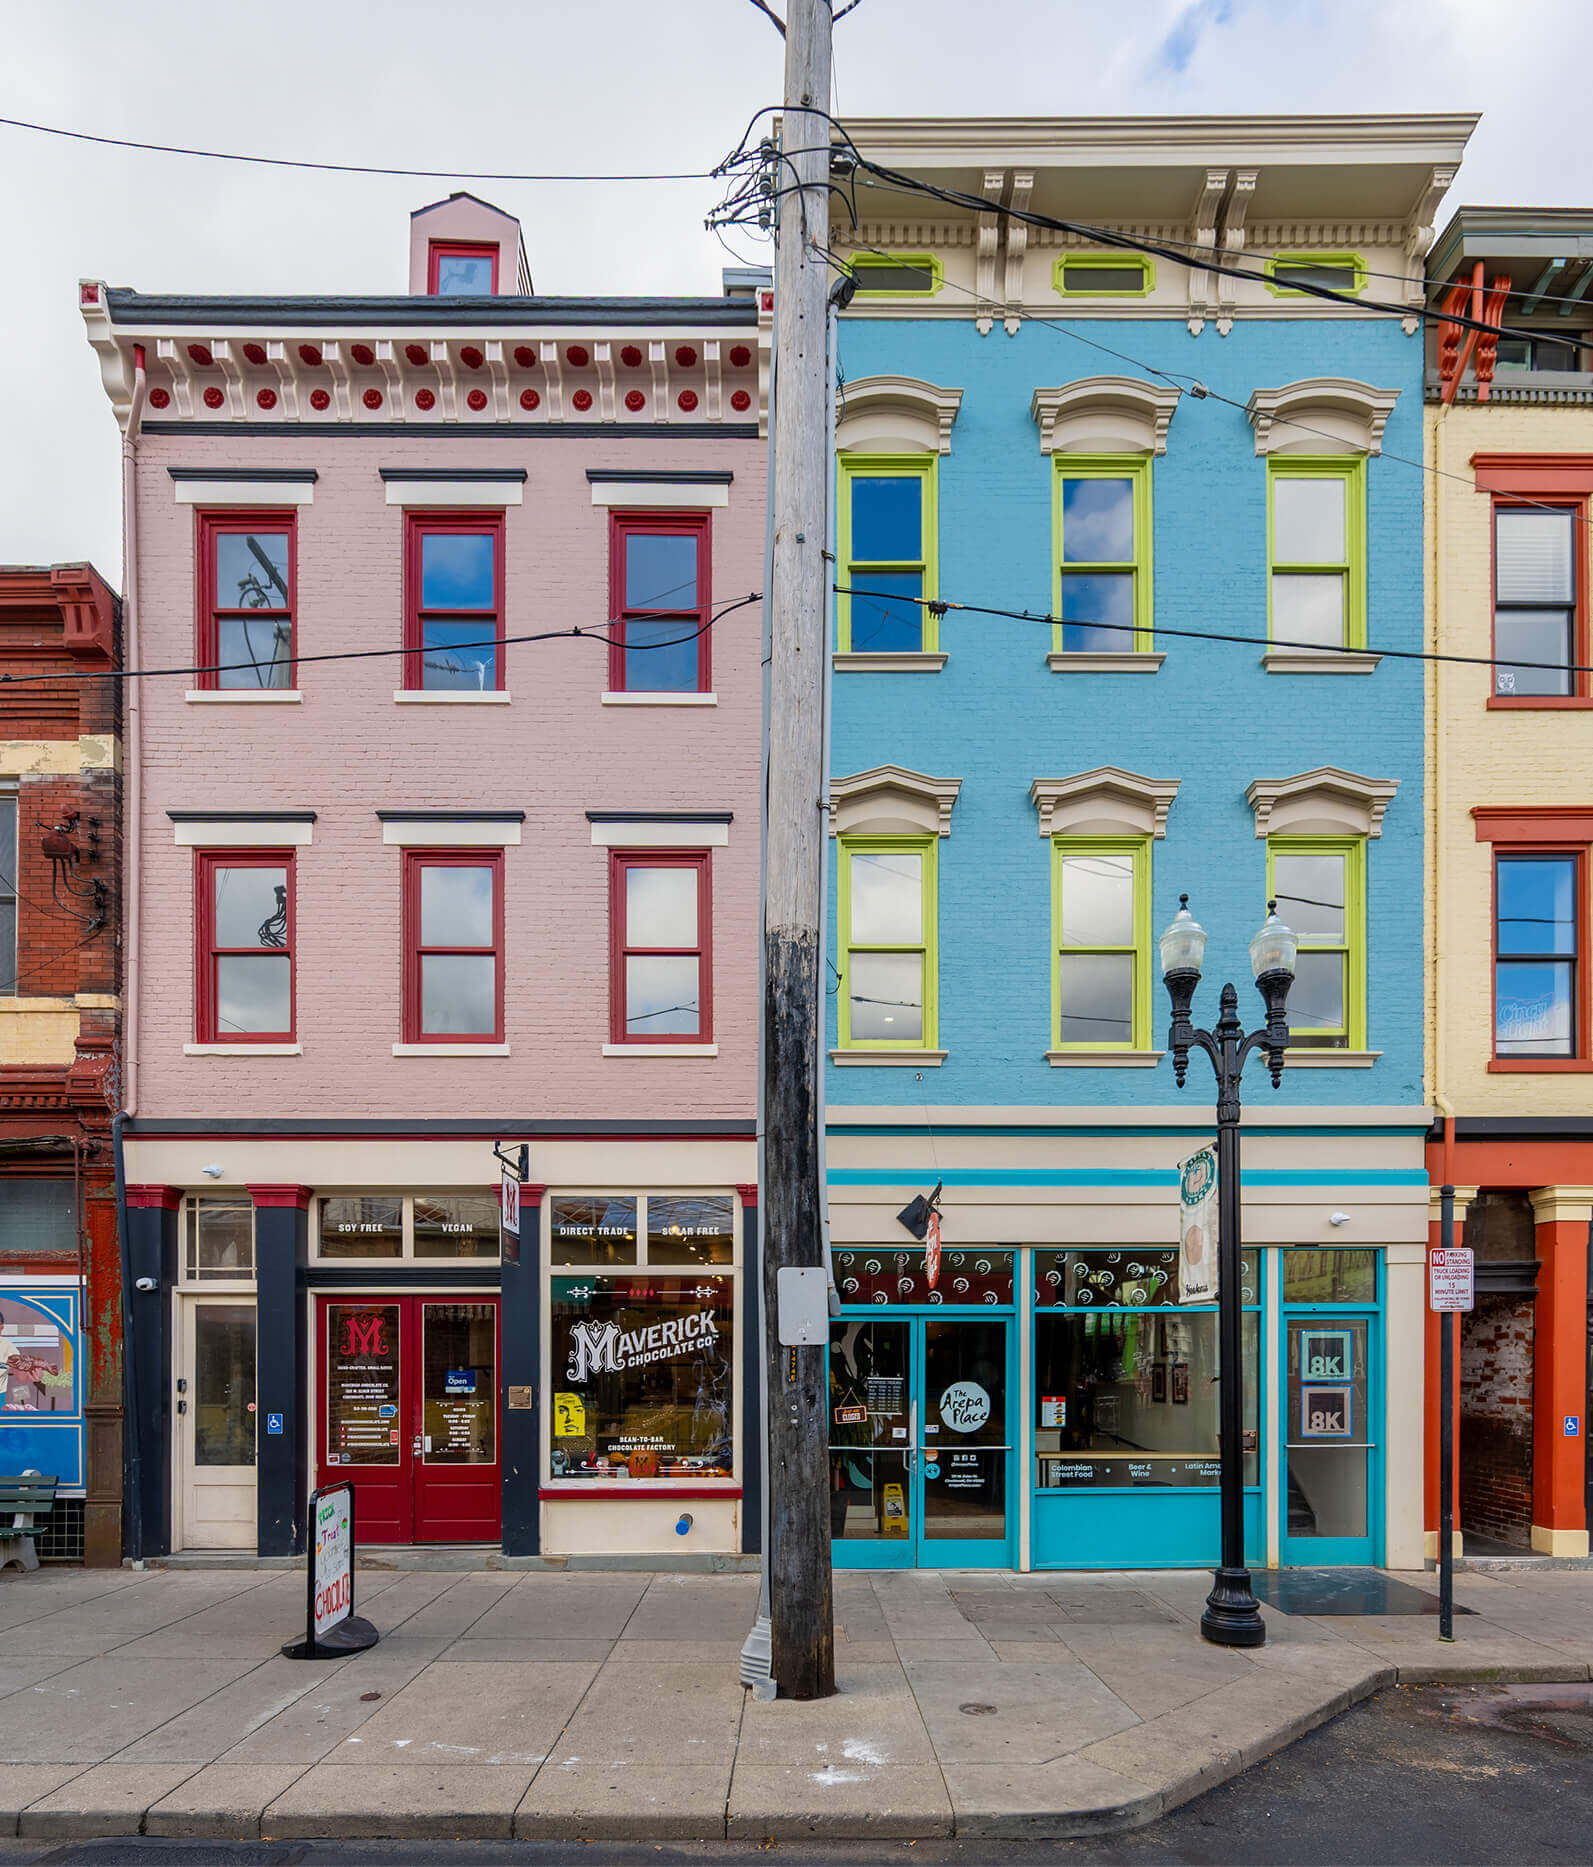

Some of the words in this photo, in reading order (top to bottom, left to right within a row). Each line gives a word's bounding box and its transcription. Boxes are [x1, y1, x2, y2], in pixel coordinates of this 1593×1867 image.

[338, 1223, 360, 1232] SOY
[361, 1223, 383, 1232] FREE
[441, 1223, 473, 1232] VEGAN
[559, 1227, 594, 1235] DIRECT
[597, 1227, 628, 1235] TRADE
[662, 1227, 693, 1236] SUAR
[697, 1227, 720, 1235] FREE
[1432, 1251, 1445, 1265] NO
[340, 1312, 390, 1356] M
[566, 1309, 720, 1383] MAVERICK
[627, 1341, 695, 1368] CHOCOLATE
[1311, 1355, 1342, 1376] 8K
[953, 1389, 968, 1398] The
[940, 1392, 984, 1413] Arepa
[953, 1408, 988, 1425] Place
[1311, 1411, 1342, 1431] 8K
[1051, 1463, 1093, 1471] Colombian
